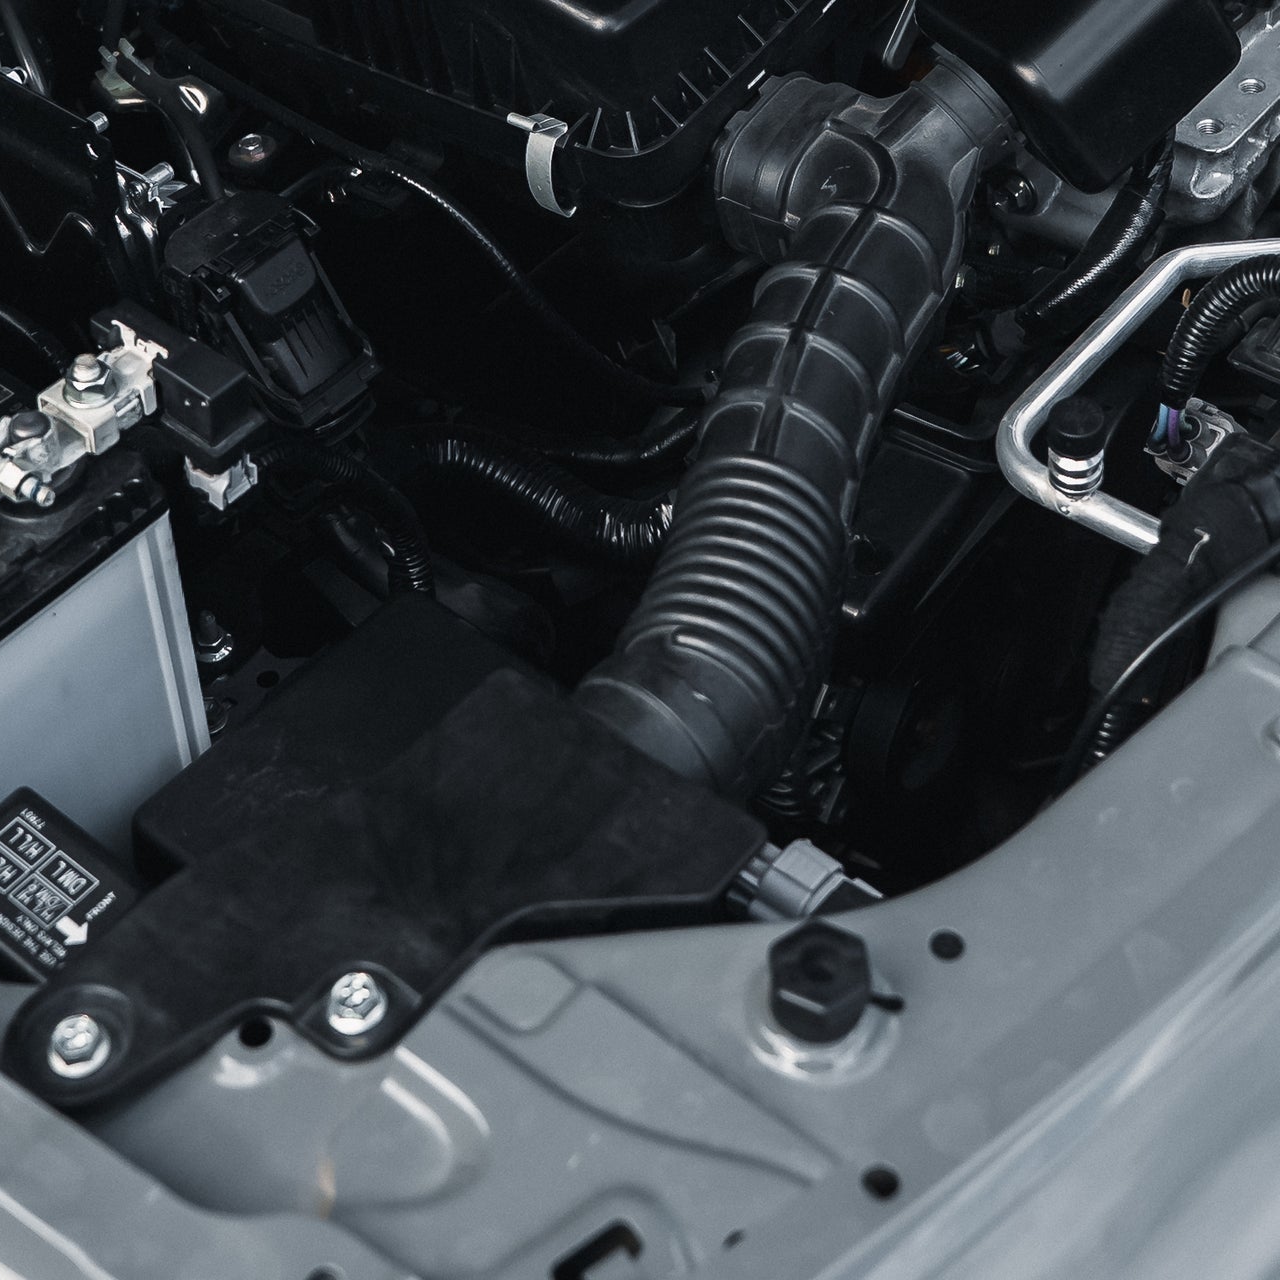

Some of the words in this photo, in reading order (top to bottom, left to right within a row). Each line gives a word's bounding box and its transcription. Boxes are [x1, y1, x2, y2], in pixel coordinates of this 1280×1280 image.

[50, 860, 67, 878] L
[57, 867, 87, 896] DIM
[85, 890, 117, 921] FRONT
